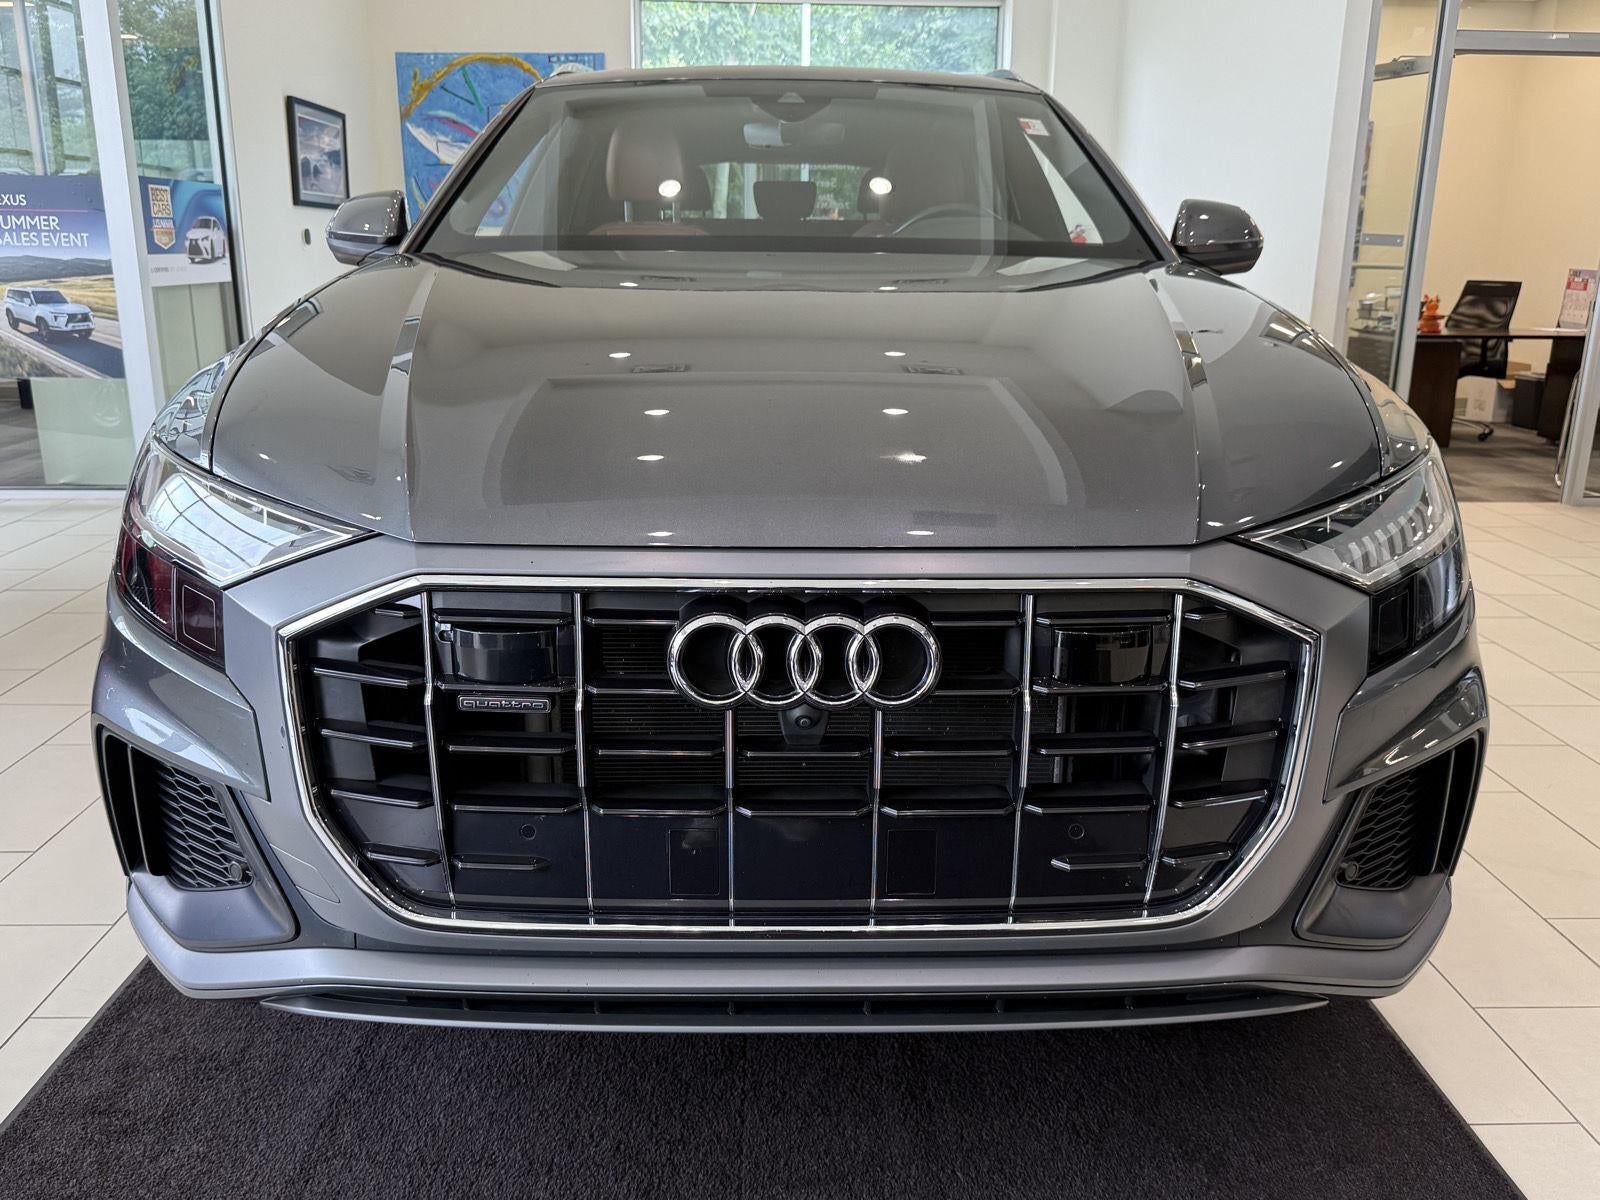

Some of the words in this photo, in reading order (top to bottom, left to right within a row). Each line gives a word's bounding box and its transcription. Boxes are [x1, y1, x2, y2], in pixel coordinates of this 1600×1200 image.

[0, 194, 26, 206] XUS
[151, 187, 169, 202] BEST
[153, 202, 172, 216] CARS
[0, 232, 39, 246] ALES
[41, 232, 89, 247] EVENT
[463, 700, 544, 709] quattro
